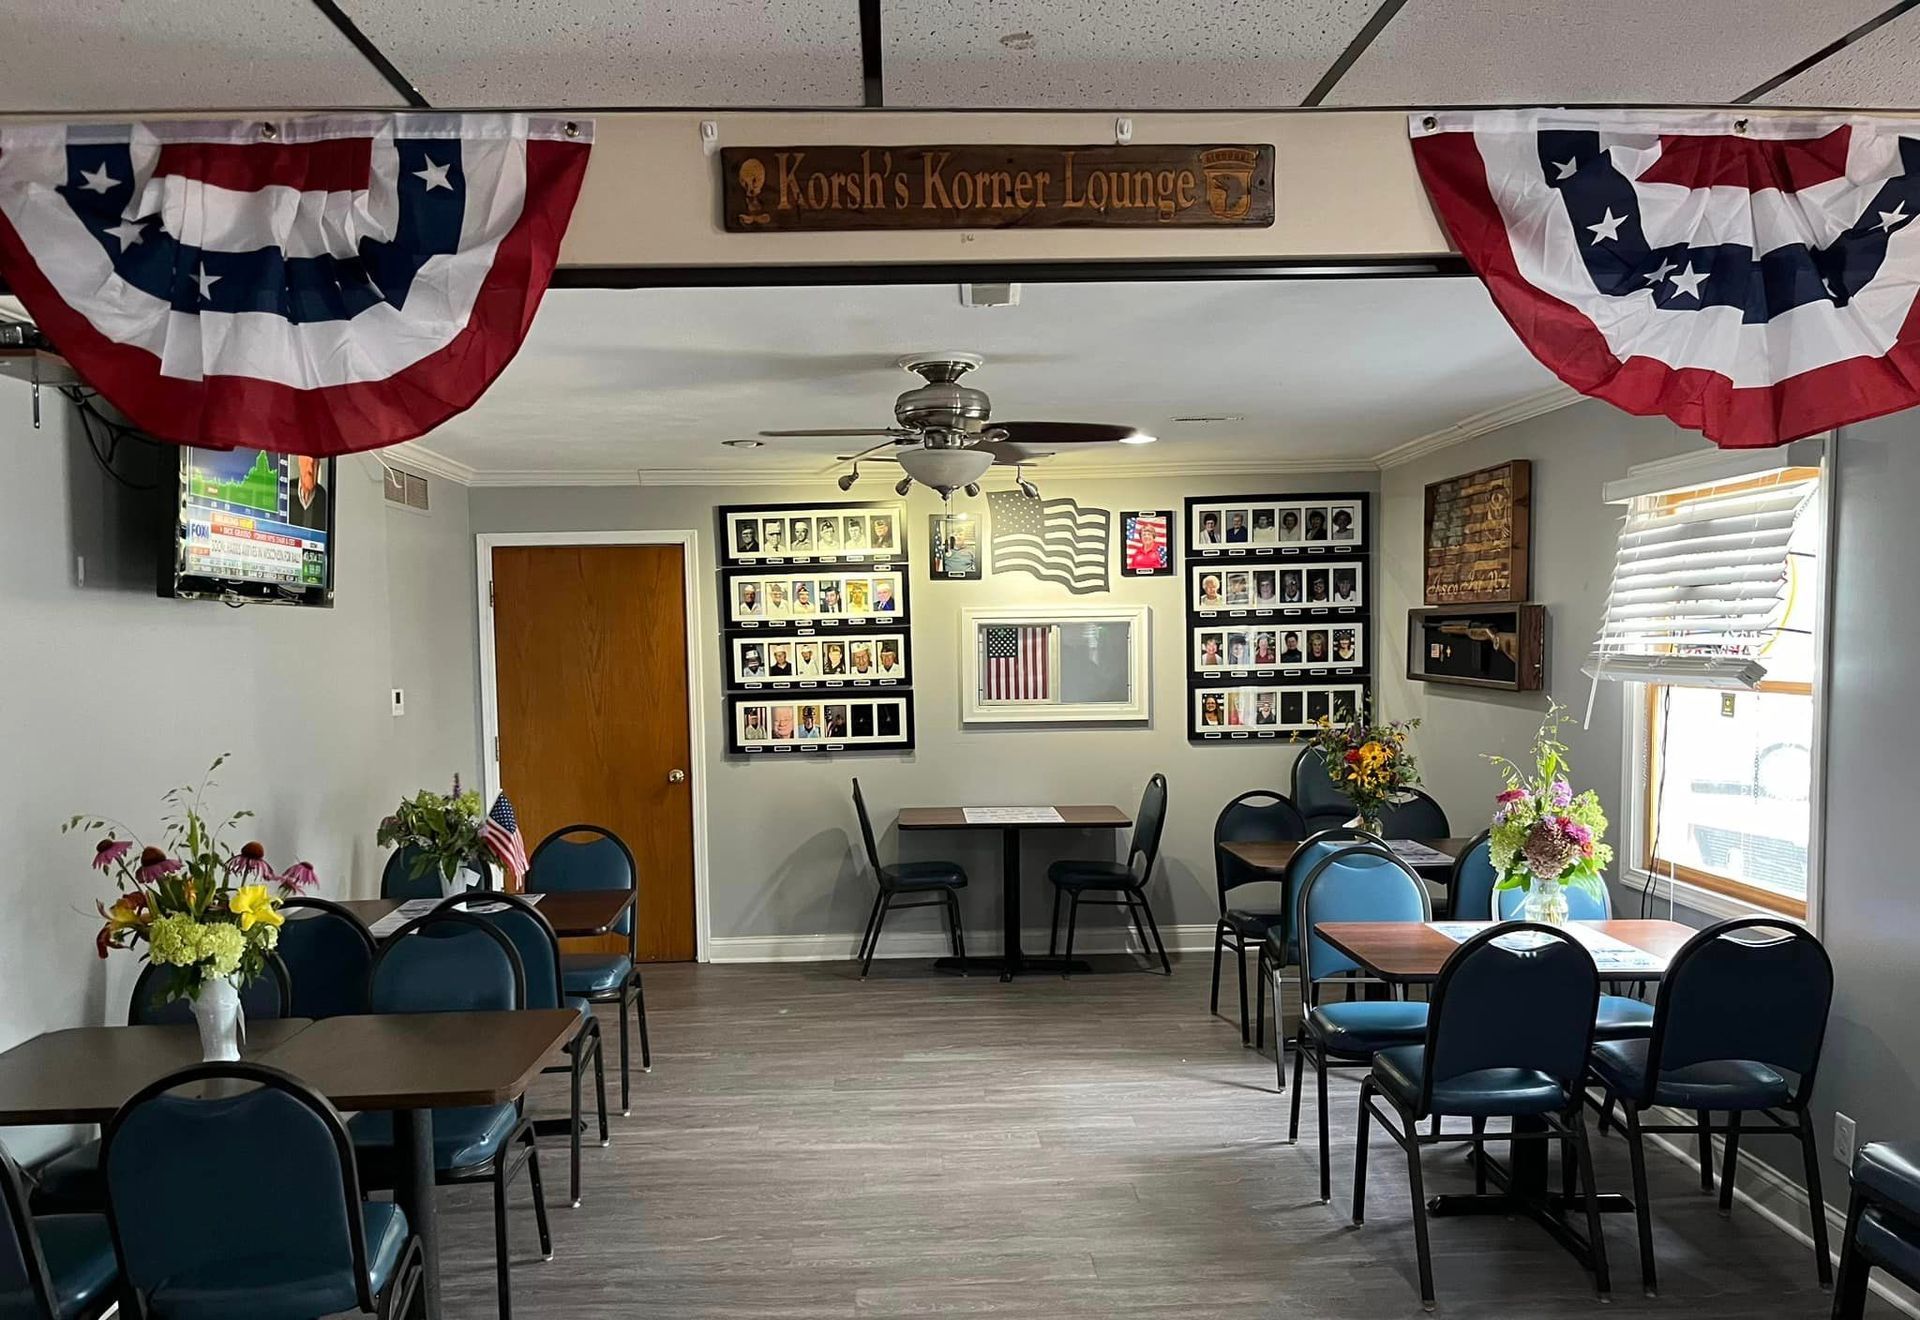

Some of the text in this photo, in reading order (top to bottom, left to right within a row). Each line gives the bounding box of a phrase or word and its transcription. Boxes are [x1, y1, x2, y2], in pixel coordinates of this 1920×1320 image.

[775, 150, 1197, 222] Korsh's Korner Lounge
